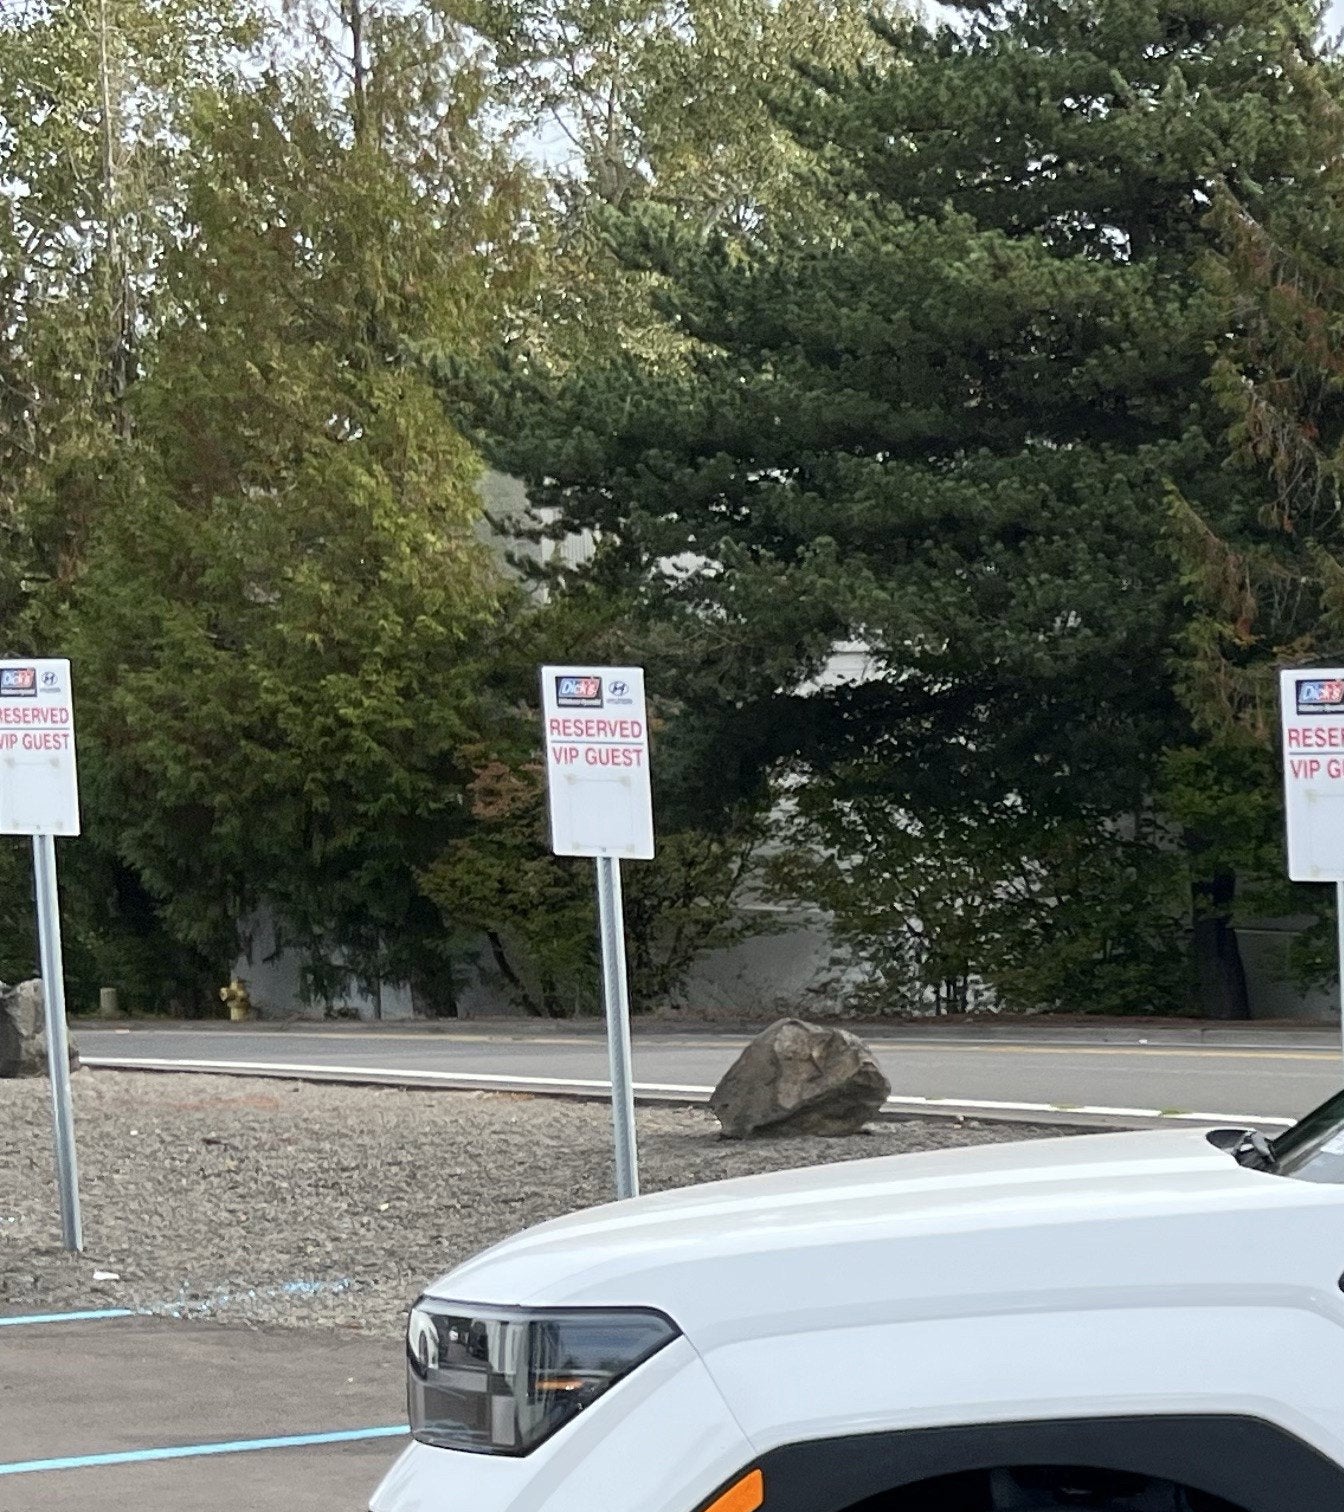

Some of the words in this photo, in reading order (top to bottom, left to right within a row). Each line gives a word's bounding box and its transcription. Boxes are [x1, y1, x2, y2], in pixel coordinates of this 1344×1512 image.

[550, 719, 642, 737] RESERVED
[22, 733, 69, 749] GUEST
[552, 747, 579, 764] VIP
[585, 748, 643, 766] GUEST
[1290, 760, 1320, 779] VIP
